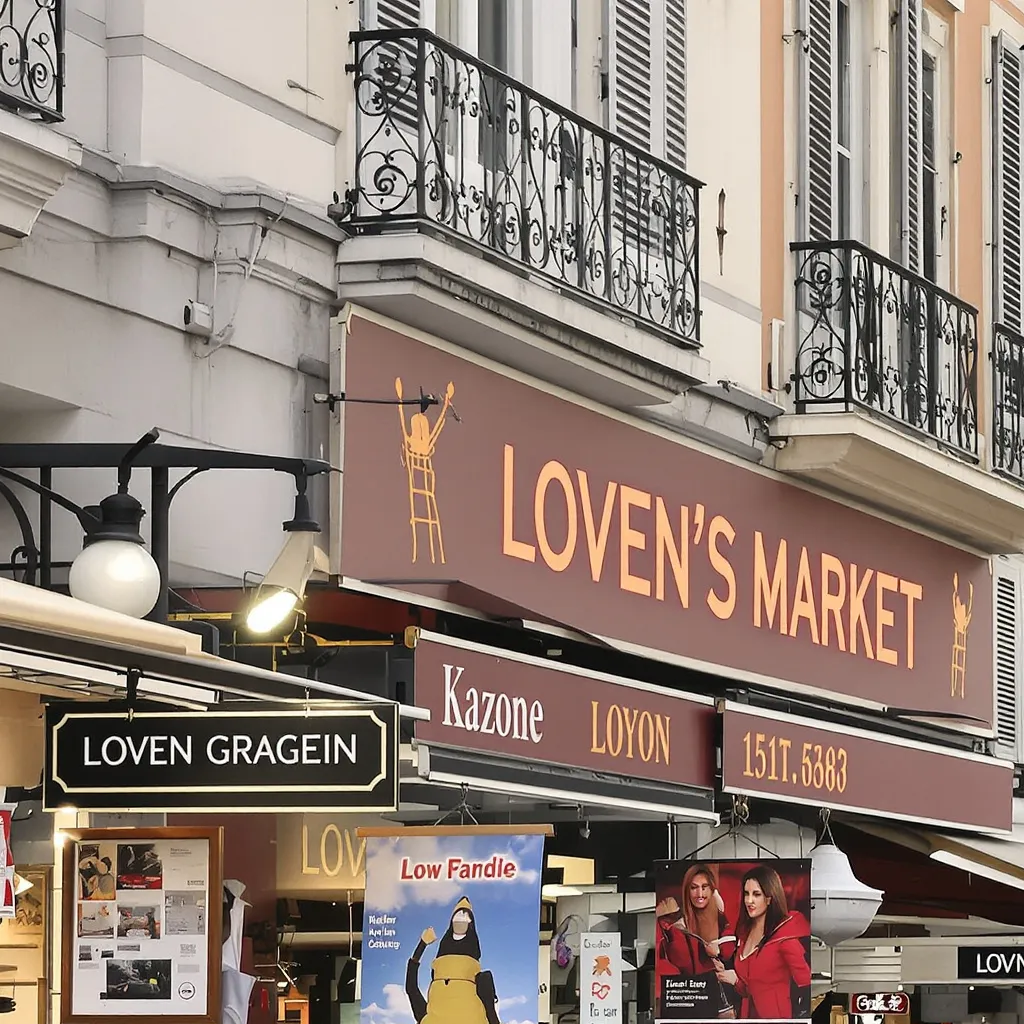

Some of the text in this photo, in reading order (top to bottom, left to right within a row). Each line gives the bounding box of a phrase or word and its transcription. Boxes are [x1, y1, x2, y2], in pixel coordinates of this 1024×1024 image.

[503, 443, 924, 670] LOVEN'S MARKET
[442, 664, 671, 766] Kazone LOYON
[83, 733, 357, 766] LOVEN GRAGEIN
[401, 856, 516, 880] Low Fandle
